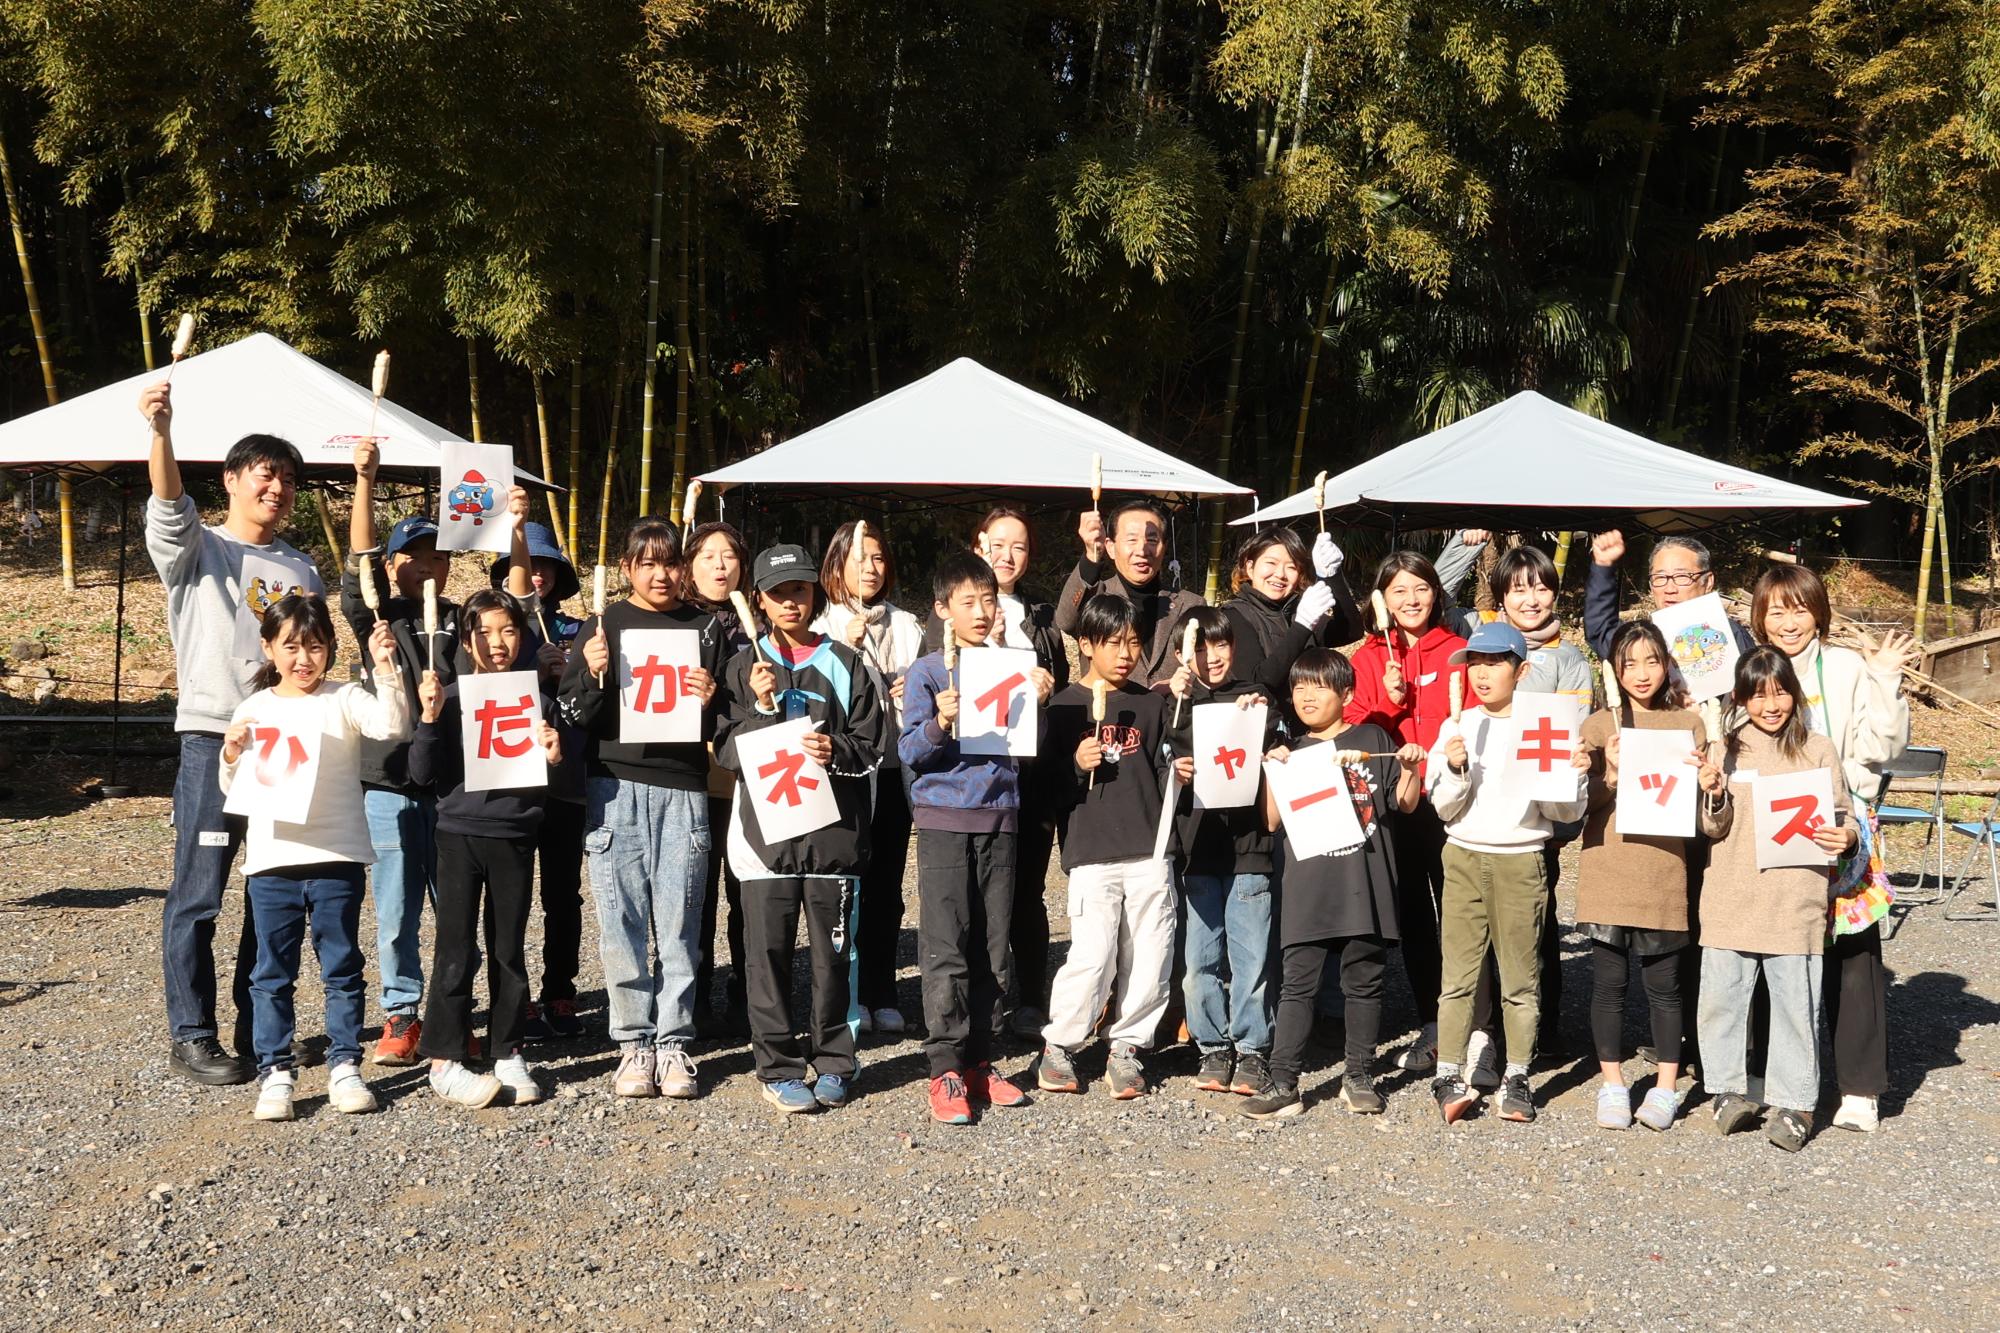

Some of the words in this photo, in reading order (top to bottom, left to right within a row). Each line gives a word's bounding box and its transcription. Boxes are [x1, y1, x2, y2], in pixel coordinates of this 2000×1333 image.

[632, 654, 696, 713] か
[974, 672, 1026, 727] イ
[474, 694, 535, 760] だ
[1516, 716, 1571, 772] キ
[255, 727, 309, 787] ひ
[758, 749, 819, 807] ネ
[1770, 794, 1826, 846] ズ
